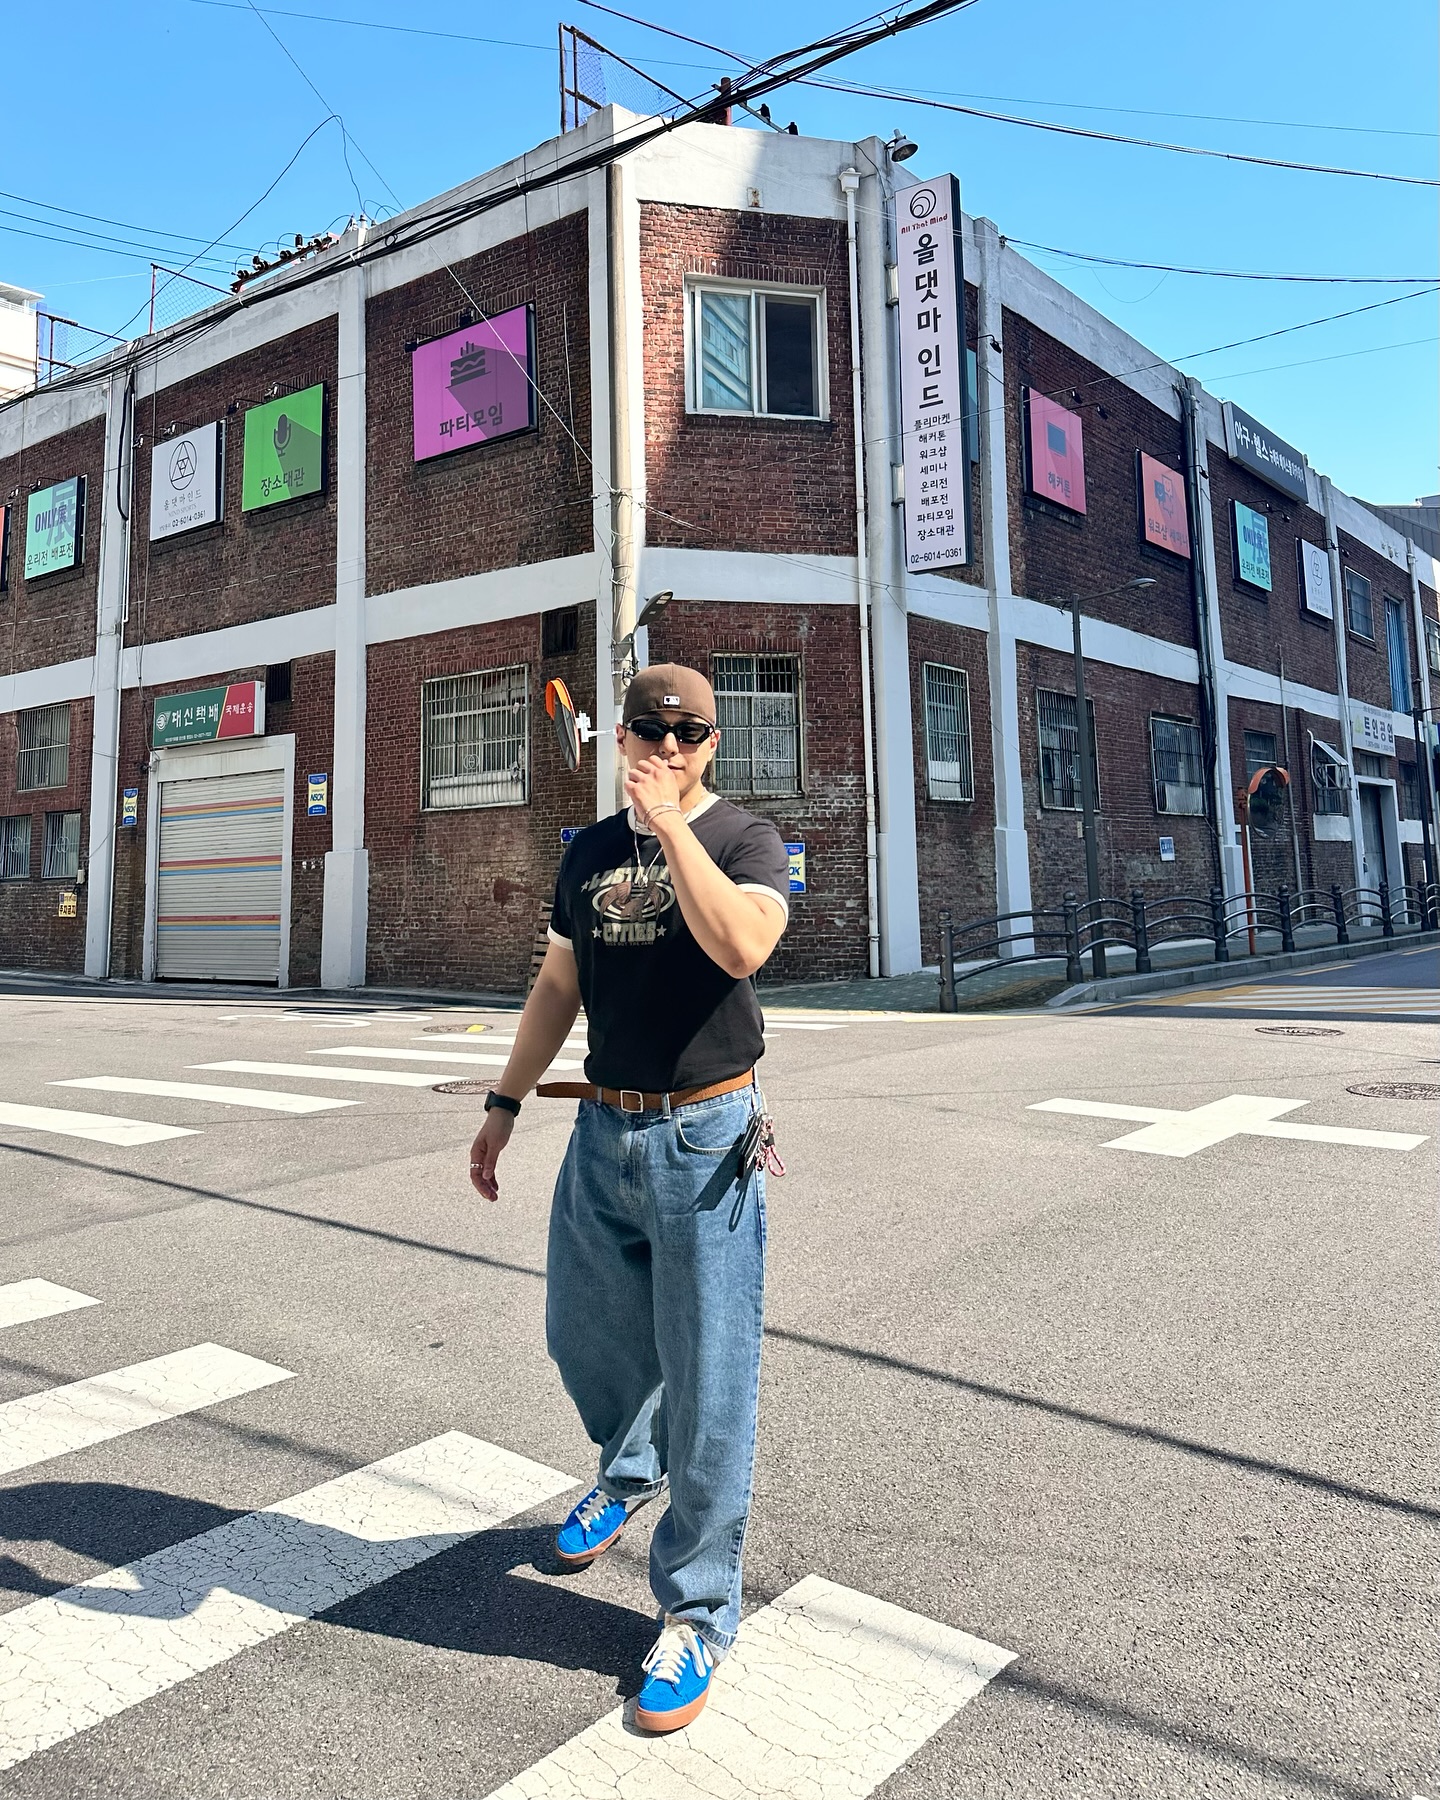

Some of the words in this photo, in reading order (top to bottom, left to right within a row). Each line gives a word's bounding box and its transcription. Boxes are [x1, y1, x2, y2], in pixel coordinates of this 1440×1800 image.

[912, 220, 928, 230] That
[930, 213, 948, 225] Mind
[913, 233, 944, 409] 올댓마인드
[440, 402, 503, 437] 파티모임
[914, 413, 951, 430] 플리마켓
[918, 430, 947, 443] 해커톤
[919, 446, 947, 459] 워크샵
[919, 462, 948, 475] 세미나
[261, 467, 305, 497] 장소대관
[920, 477, 948, 492] 온리전
[920, 494, 948, 506] 배포전
[917, 509, 954, 523] 파티모임
[917, 525, 955, 541] 장소대관
[27, 550, 48, 571] 온리전
[51, 542, 73, 559] 배포전
[910, 547, 962, 564] 02-6014-0361
[171, 703, 219, 728] 대신택배
[225, 702, 254, 716] 국제운송
